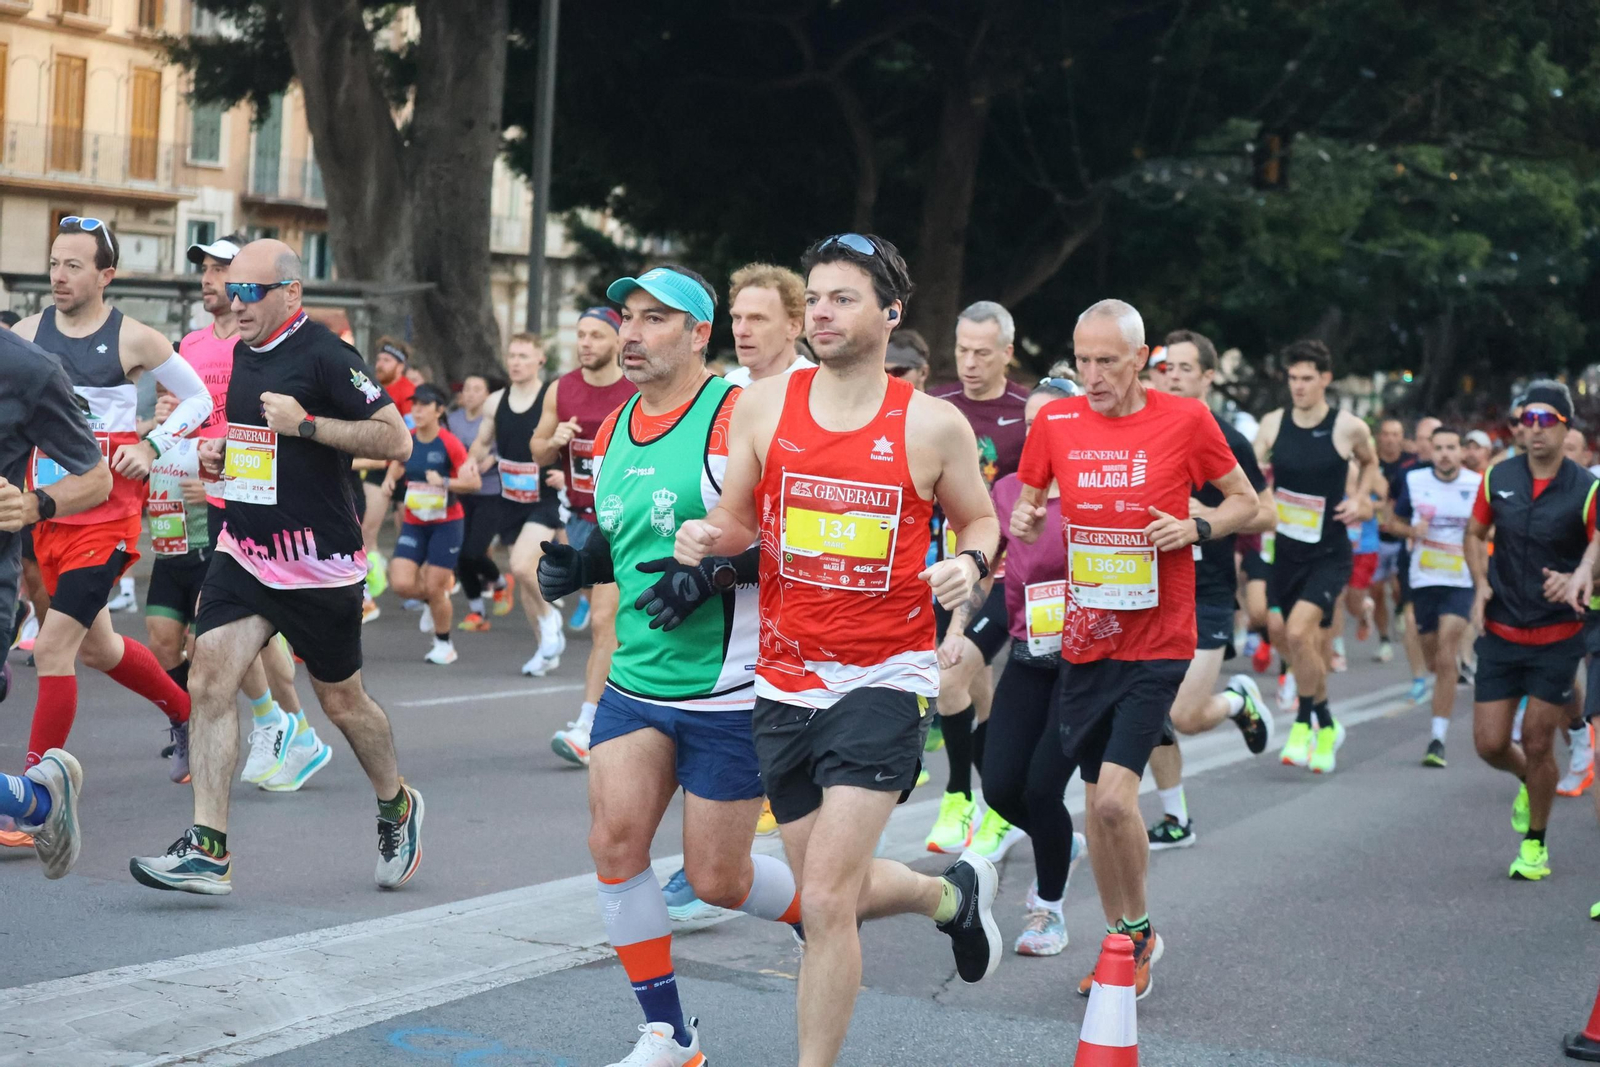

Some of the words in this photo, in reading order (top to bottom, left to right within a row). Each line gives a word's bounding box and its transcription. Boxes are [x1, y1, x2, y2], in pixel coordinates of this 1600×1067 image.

[235, 428, 271, 443] GENERALI
[870, 453, 894, 462] luanvi
[1080, 450, 1129, 460] GENERALI
[1077, 469, 1128, 488] MÁLAGA
[813, 483, 892, 508] GENERALI
[817, 517, 857, 541] 134
[823, 540, 847, 550] MARC
[1089, 532, 1149, 546] GENERALI
[853, 565, 874, 573] 42K
[1085, 557, 1137, 574] 13620
[272, 730, 284, 760] HOKA
